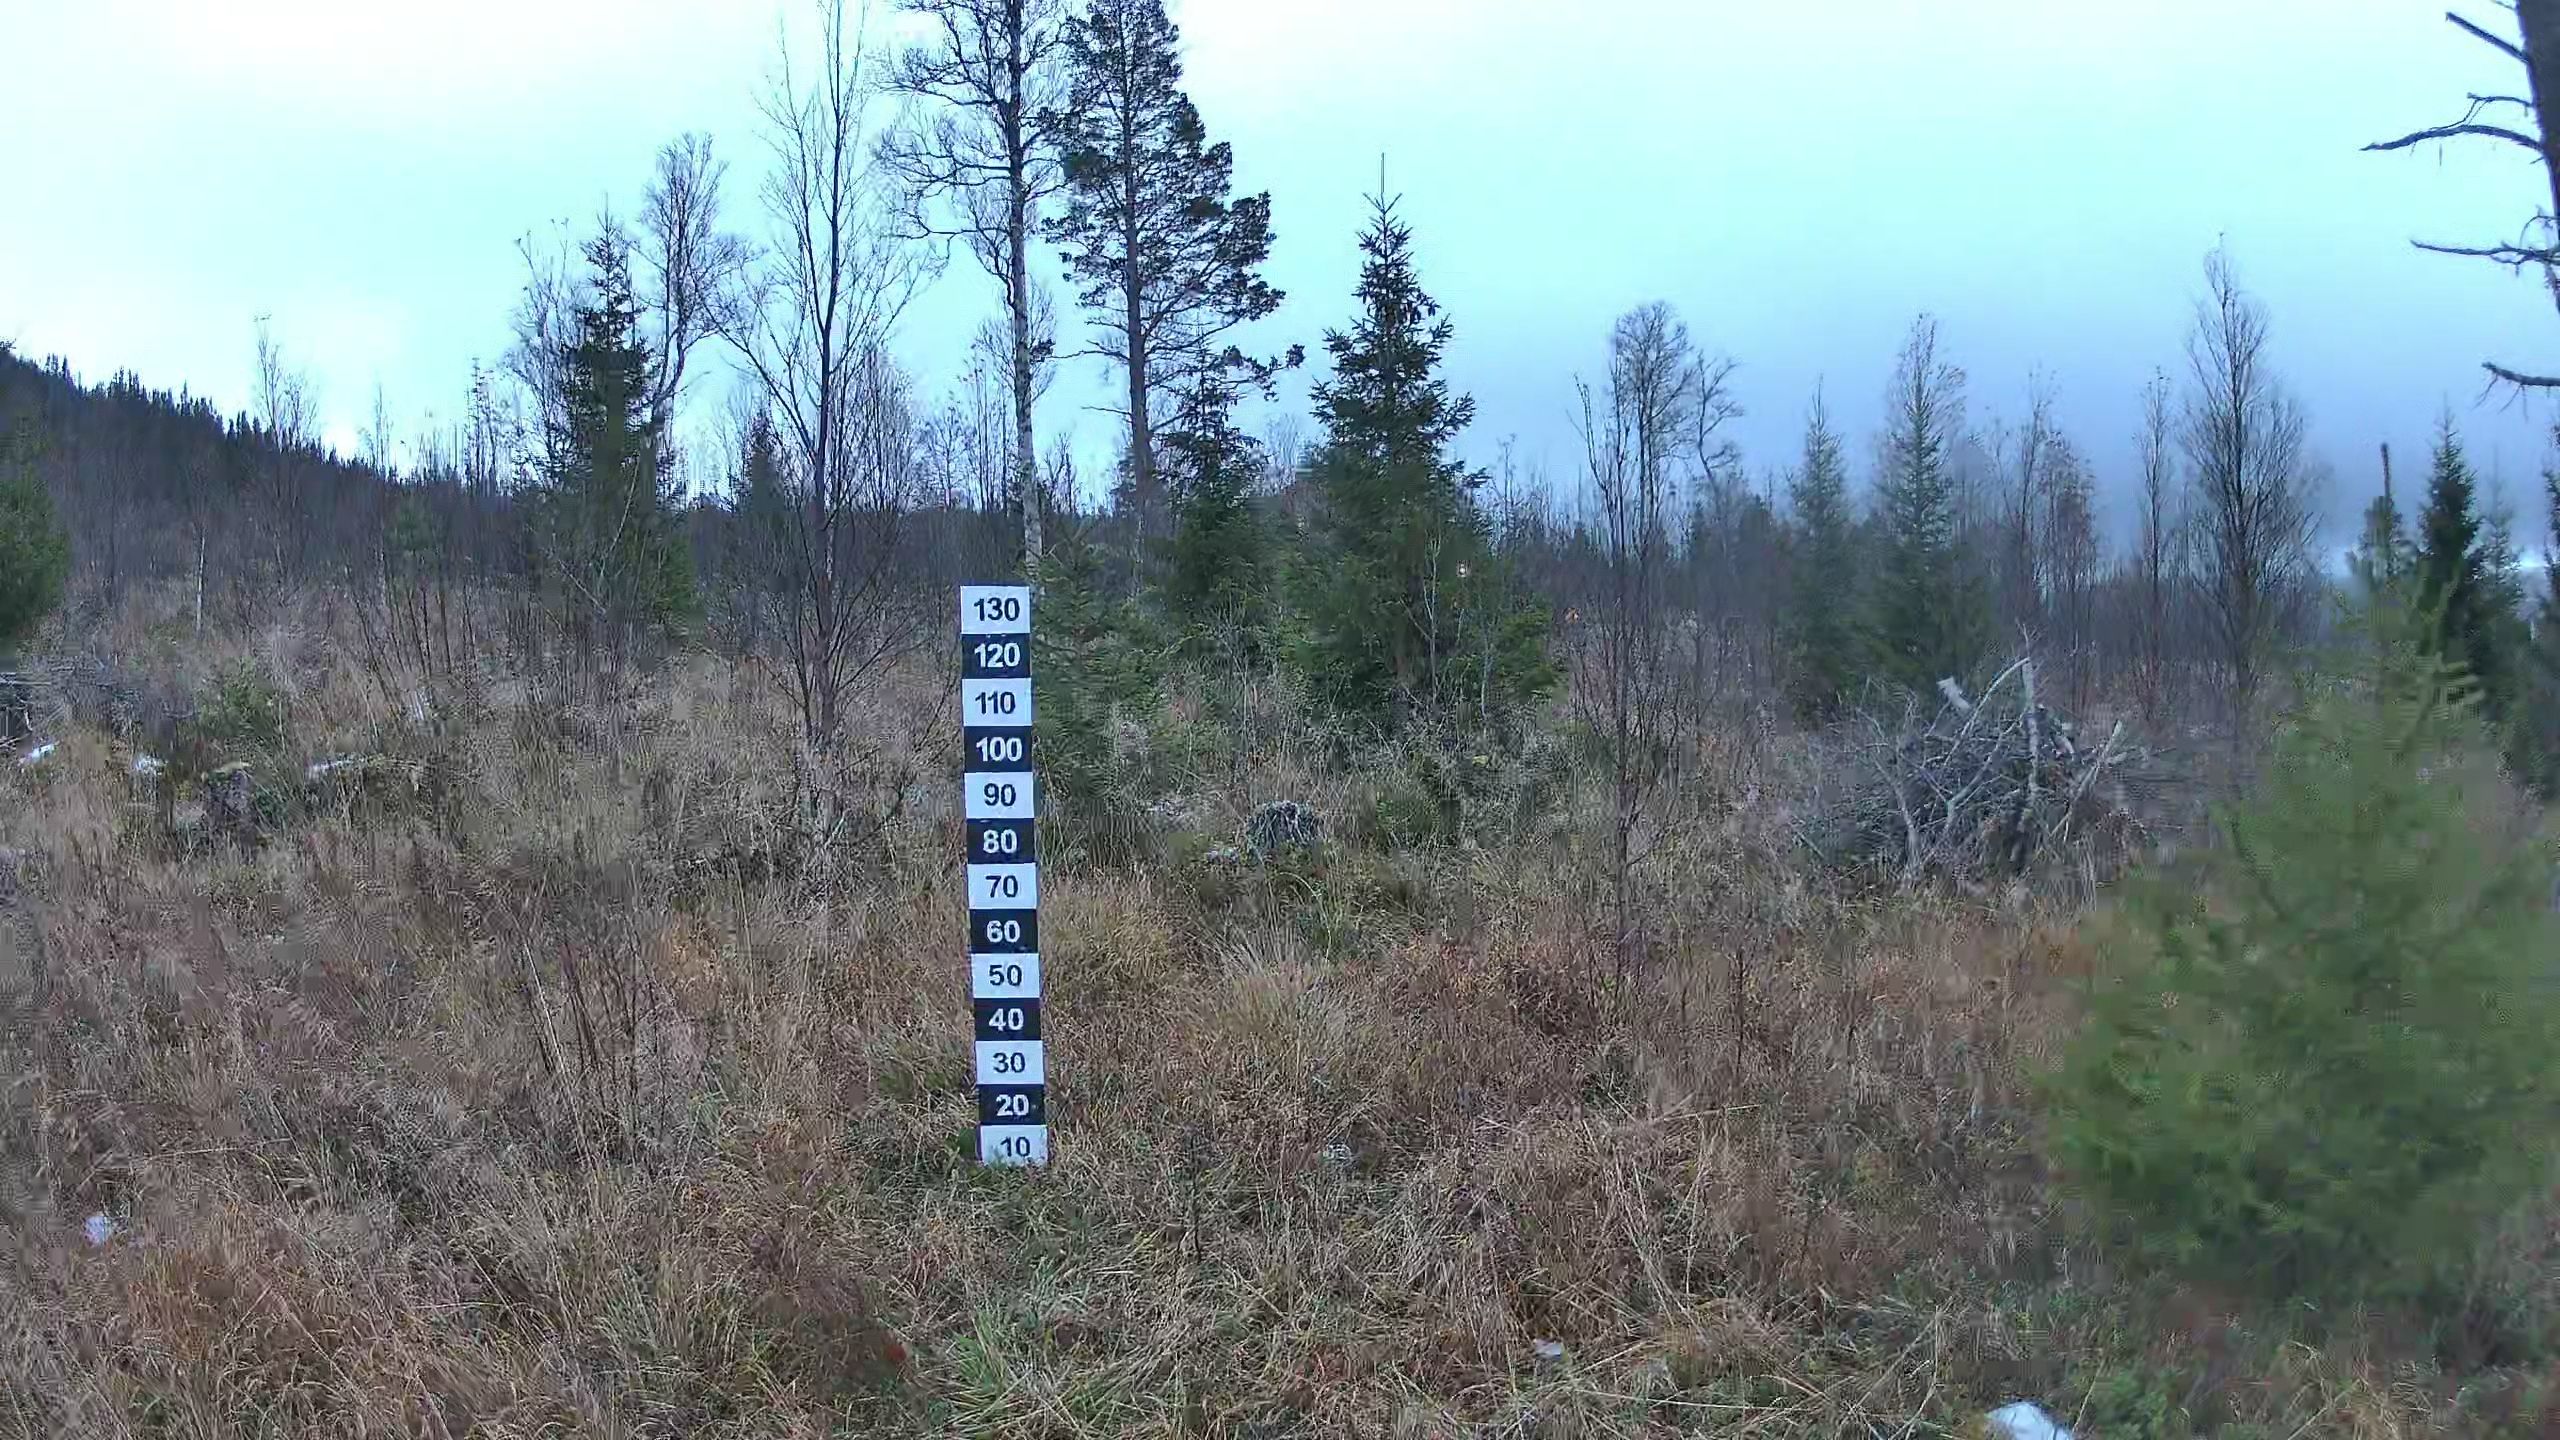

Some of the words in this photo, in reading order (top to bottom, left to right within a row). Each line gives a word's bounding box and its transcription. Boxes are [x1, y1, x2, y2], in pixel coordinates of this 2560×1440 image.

[973, 597, 1021, 622] 130
[974, 642, 1021, 668] 120
[974, 691, 1016, 715] 110
[975, 736, 1023, 762] 100
[983, 782, 1017, 807] 90
[982, 828, 1018, 854] 80
[985, 874, 1019, 899] 70
[986, 919, 1021, 943] 60
[988, 964, 1023, 987] 50
[988, 1007, 1024, 1031] 40
[992, 1052, 1026, 1074] 30
[995, 1094, 1030, 1117] 20
[1000, 1136, 1031, 1158] 10
